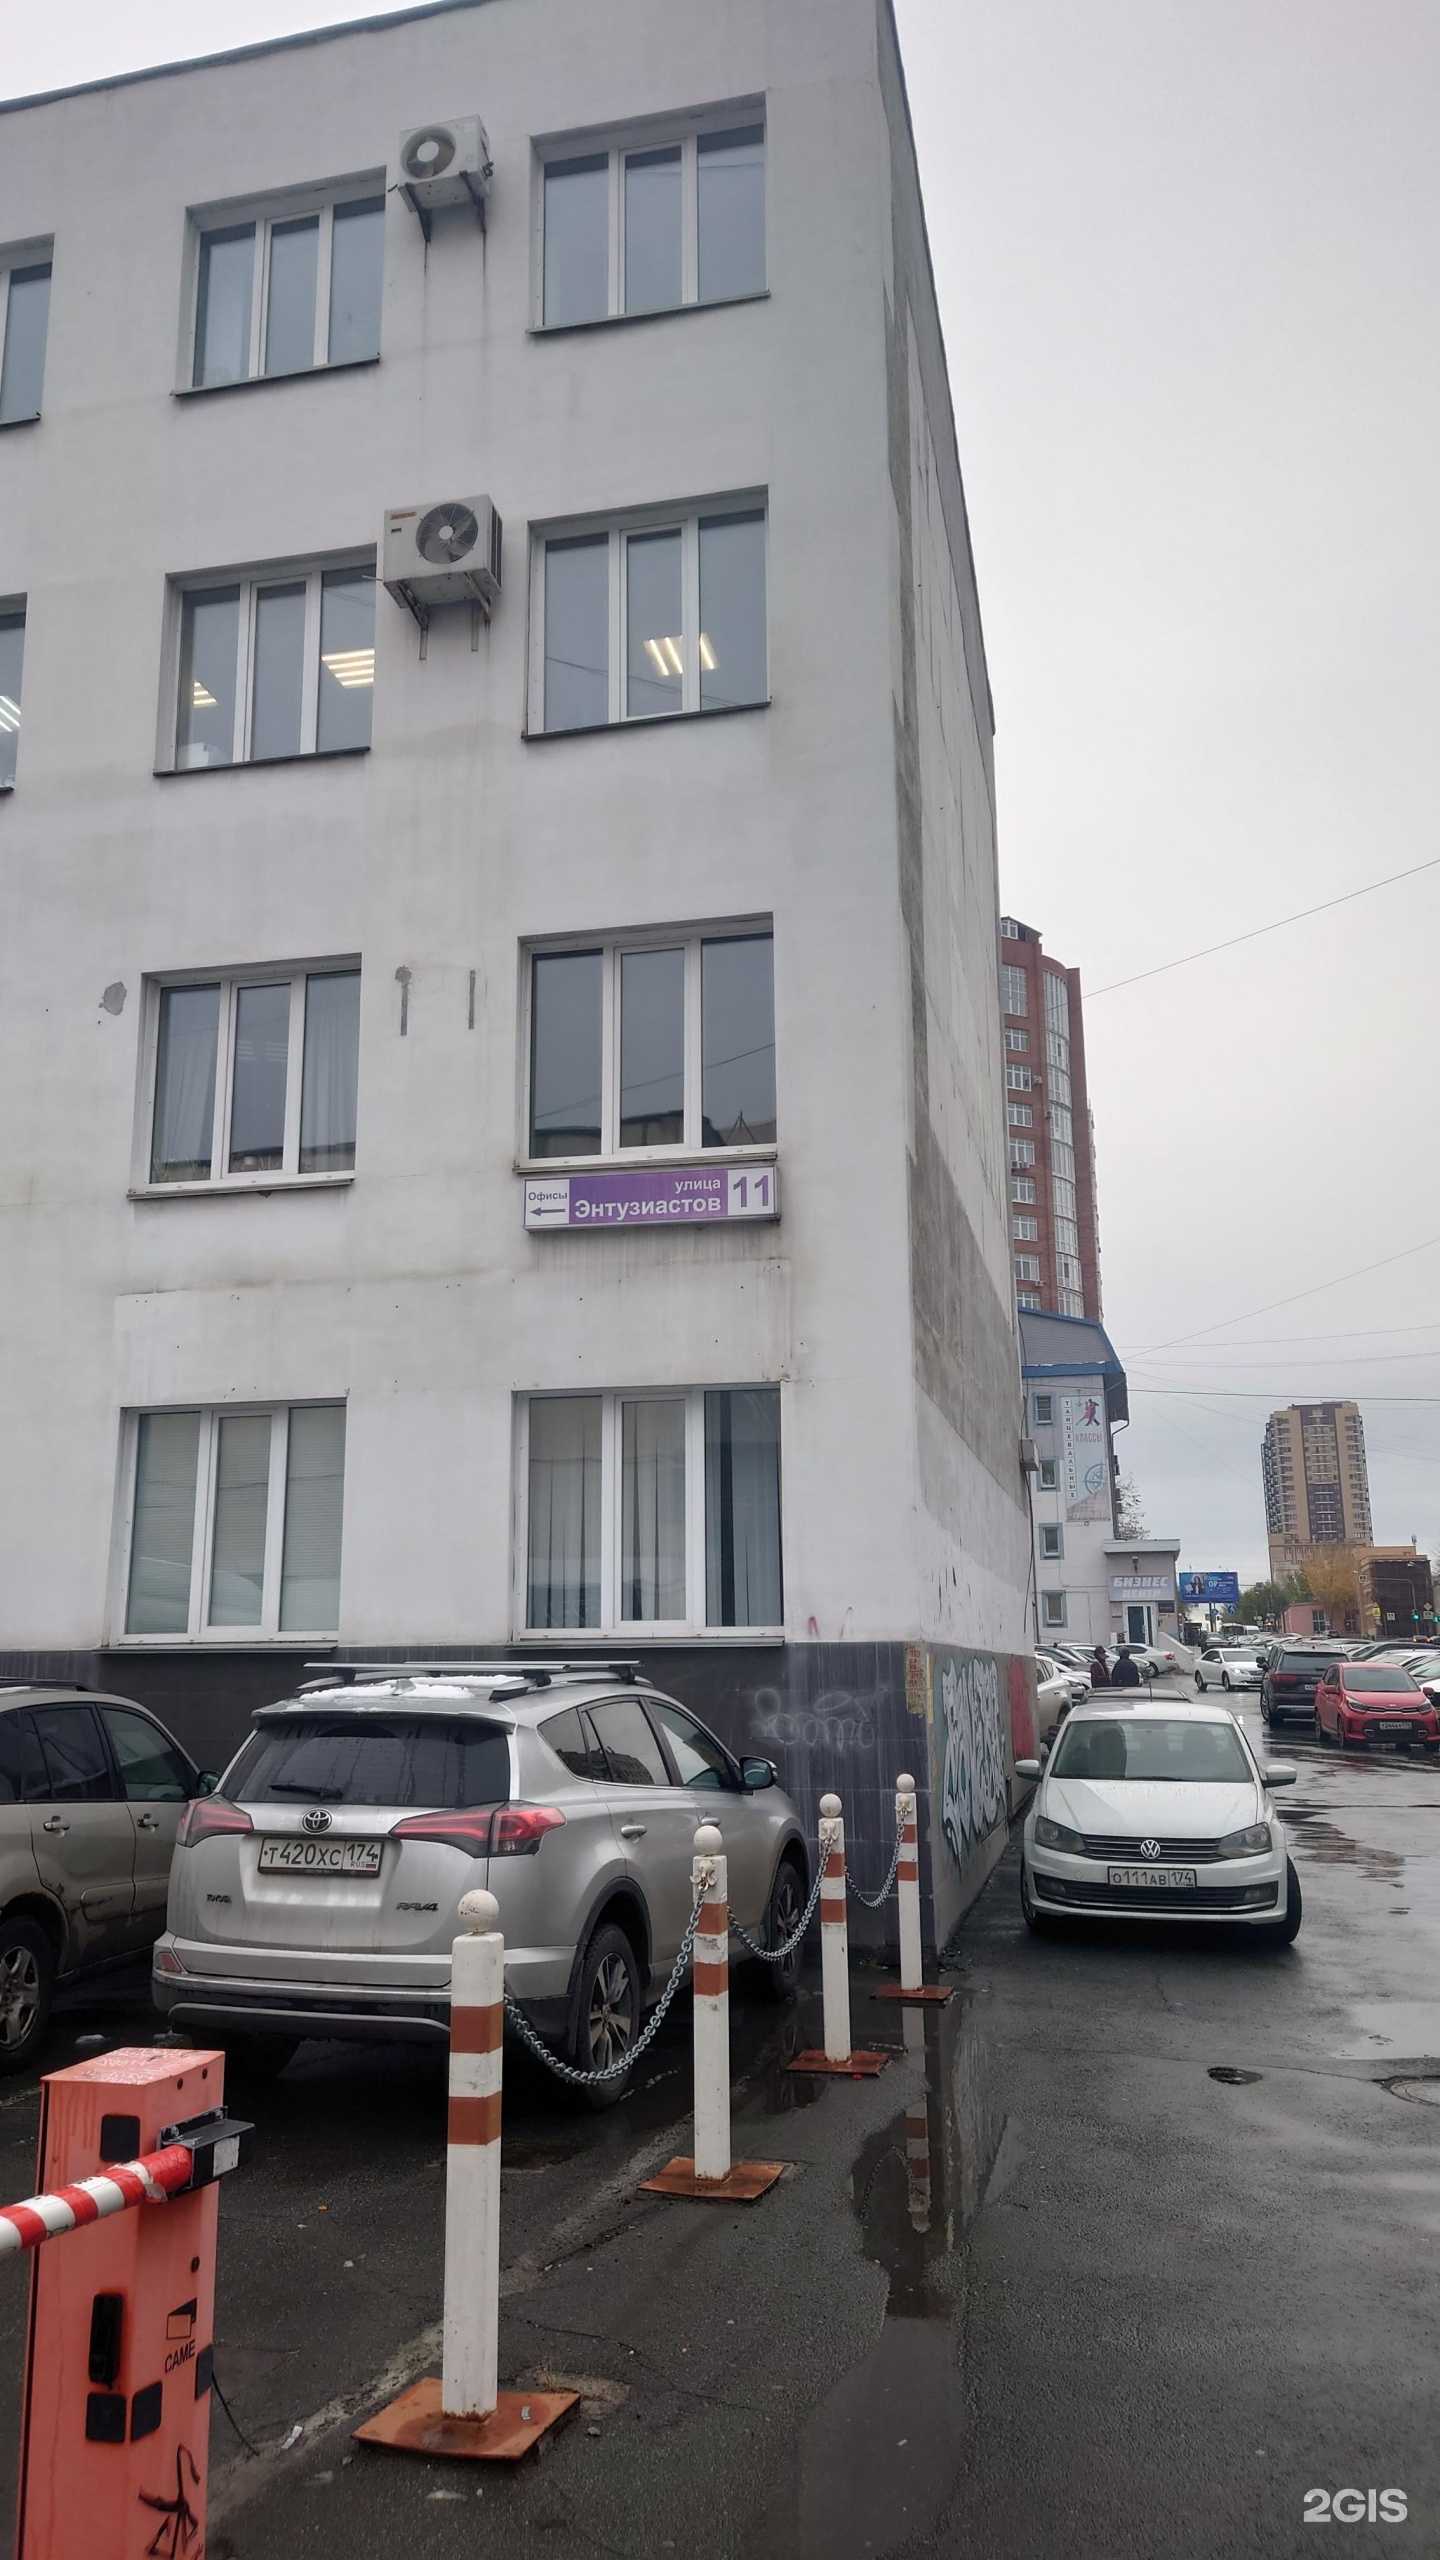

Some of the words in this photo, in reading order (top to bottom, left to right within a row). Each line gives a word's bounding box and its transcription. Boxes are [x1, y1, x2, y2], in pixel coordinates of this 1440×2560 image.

[675, 1178, 721, 1194] улица
[732, 1174, 769, 1208] 11
[528, 1191, 568, 1203] Офисы
[575, 1197, 721, 1221] Энтузиастов
[1113, 1576, 1169, 1588] БИЗНЕС
[347, 1842, 376, 1863] 174
[1171, 1869, 1194, 1885] 174
[164, 2339, 196, 2373] CAME
